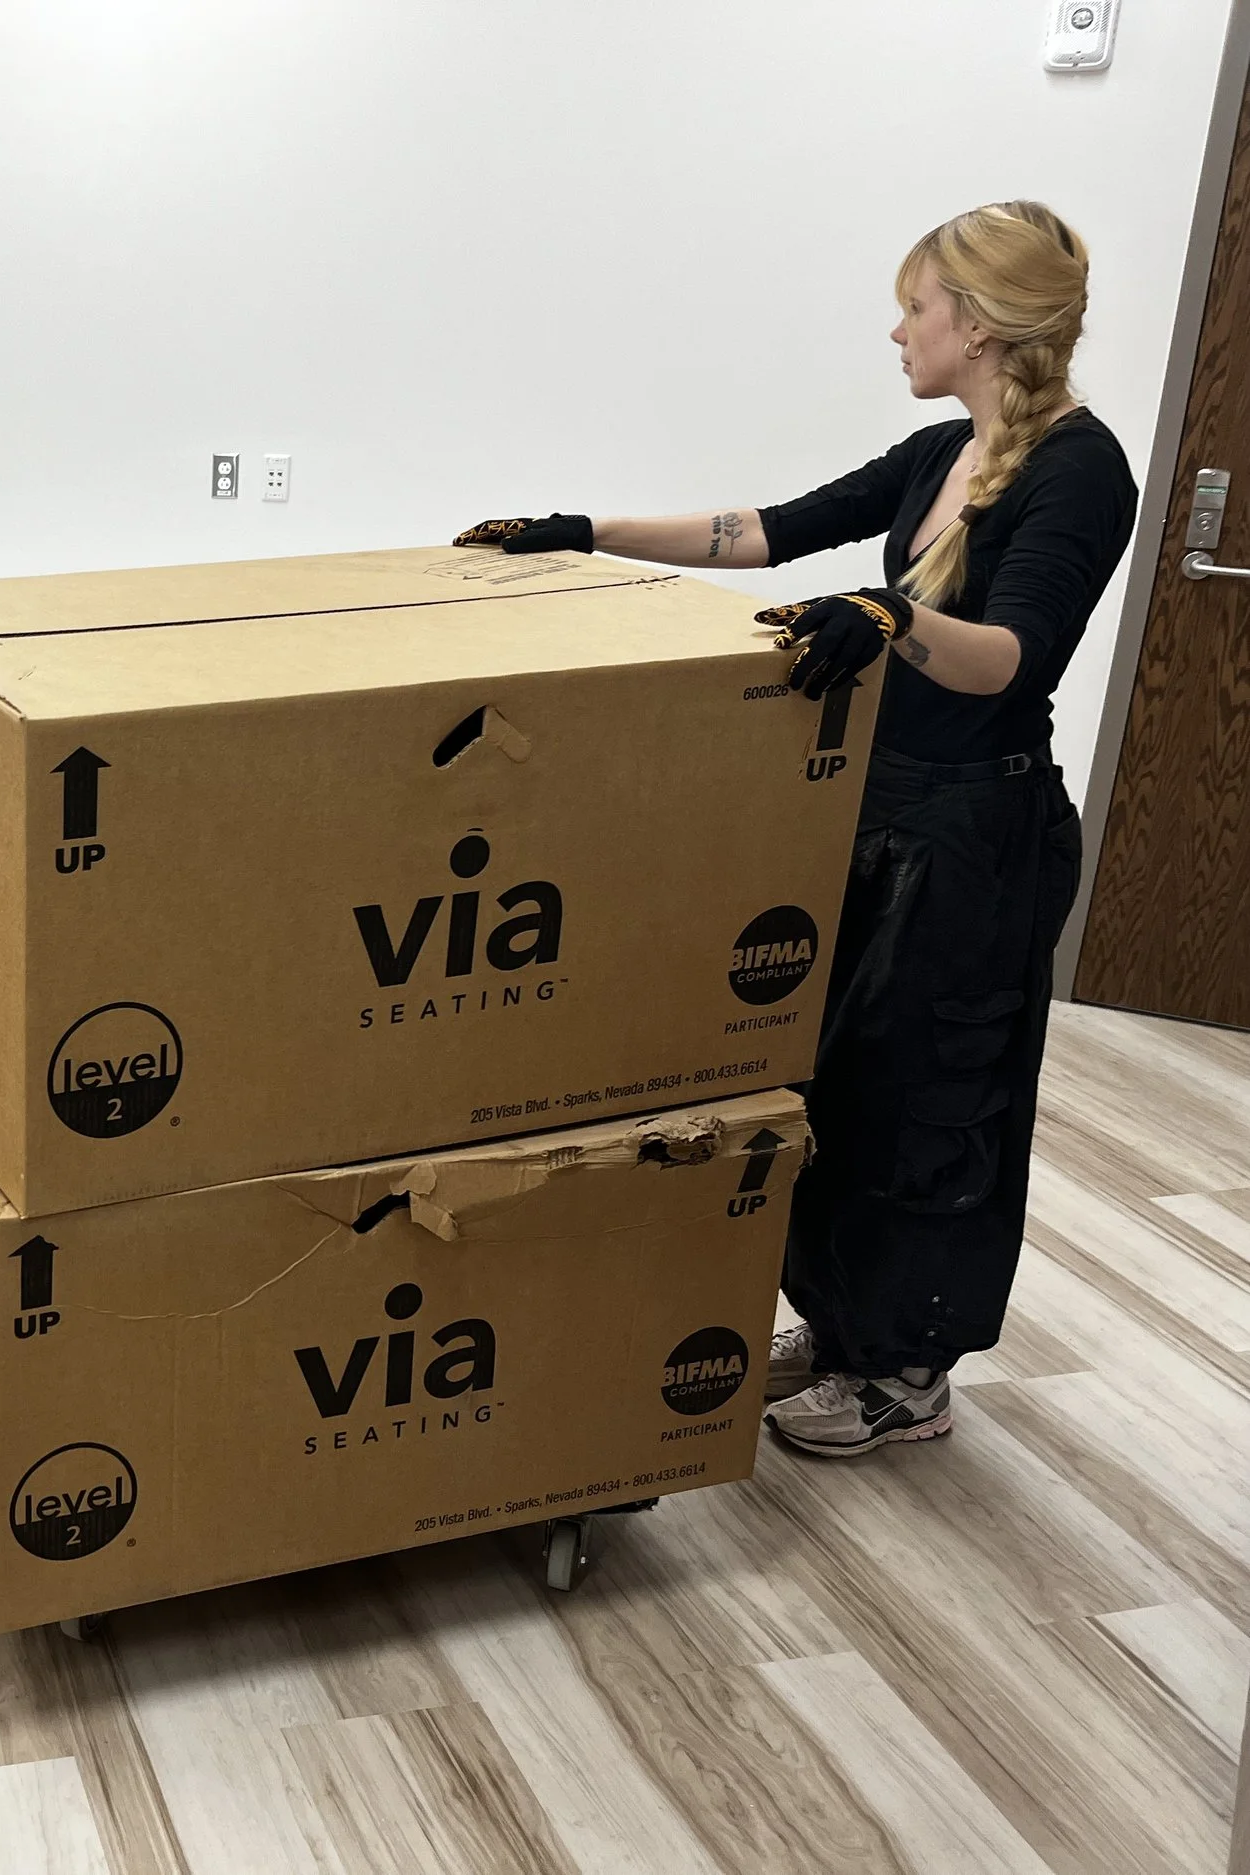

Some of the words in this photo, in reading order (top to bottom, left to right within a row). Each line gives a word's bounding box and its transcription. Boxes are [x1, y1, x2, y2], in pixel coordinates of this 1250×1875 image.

[743, 684, 789, 701] 600026
[806, 755, 847, 782] UP
[55, 844, 106, 874] UP
[352, 835, 563, 988] via
[729, 938, 812, 972] BIFMA
[736, 963, 812, 983] COMPLIANT
[358, 980, 555, 1029] SEATING
[724, 1011, 799, 1035] PARTICIPANT
[63, 1043, 168, 1093] level
[470, 1107, 493, 1124] 205
[495, 1104, 522, 1119] Vista
[525, 1098, 551, 1114] Blvd.
[563, 1089, 602, 1108] Sparks,
[605, 1081, 644, 1100] Nevada
[647, 1073, 682, 1092] 89434
[693, 1058, 768, 1084] 800.433.6614
[106, 1098, 123, 1121] 2
[727, 1194, 768, 1218] UP
[14, 1311, 60, 1339] UP
[293, 1283, 496, 1419] via
[661, 1354, 744, 1388] BIFMA
[669, 1375, 743, 1397] COMPLIANT
[303, 1405, 491, 1455] SEATING
[660, 1419, 734, 1443] PARTICIPANT
[25, 1476, 123, 1524] level
[414, 1516, 436, 1532] 205
[438, 1514, 464, 1527] Vista
[467, 1507, 493, 1521] Blvd.
[504, 1497, 543, 1514] Sparks,
[545, 1486, 584, 1505] Nevada
[586, 1478, 621, 1497] 89434
[632, 1461, 706, 1487] 800.433.6614
[66, 1525, 81, 1546] 2
